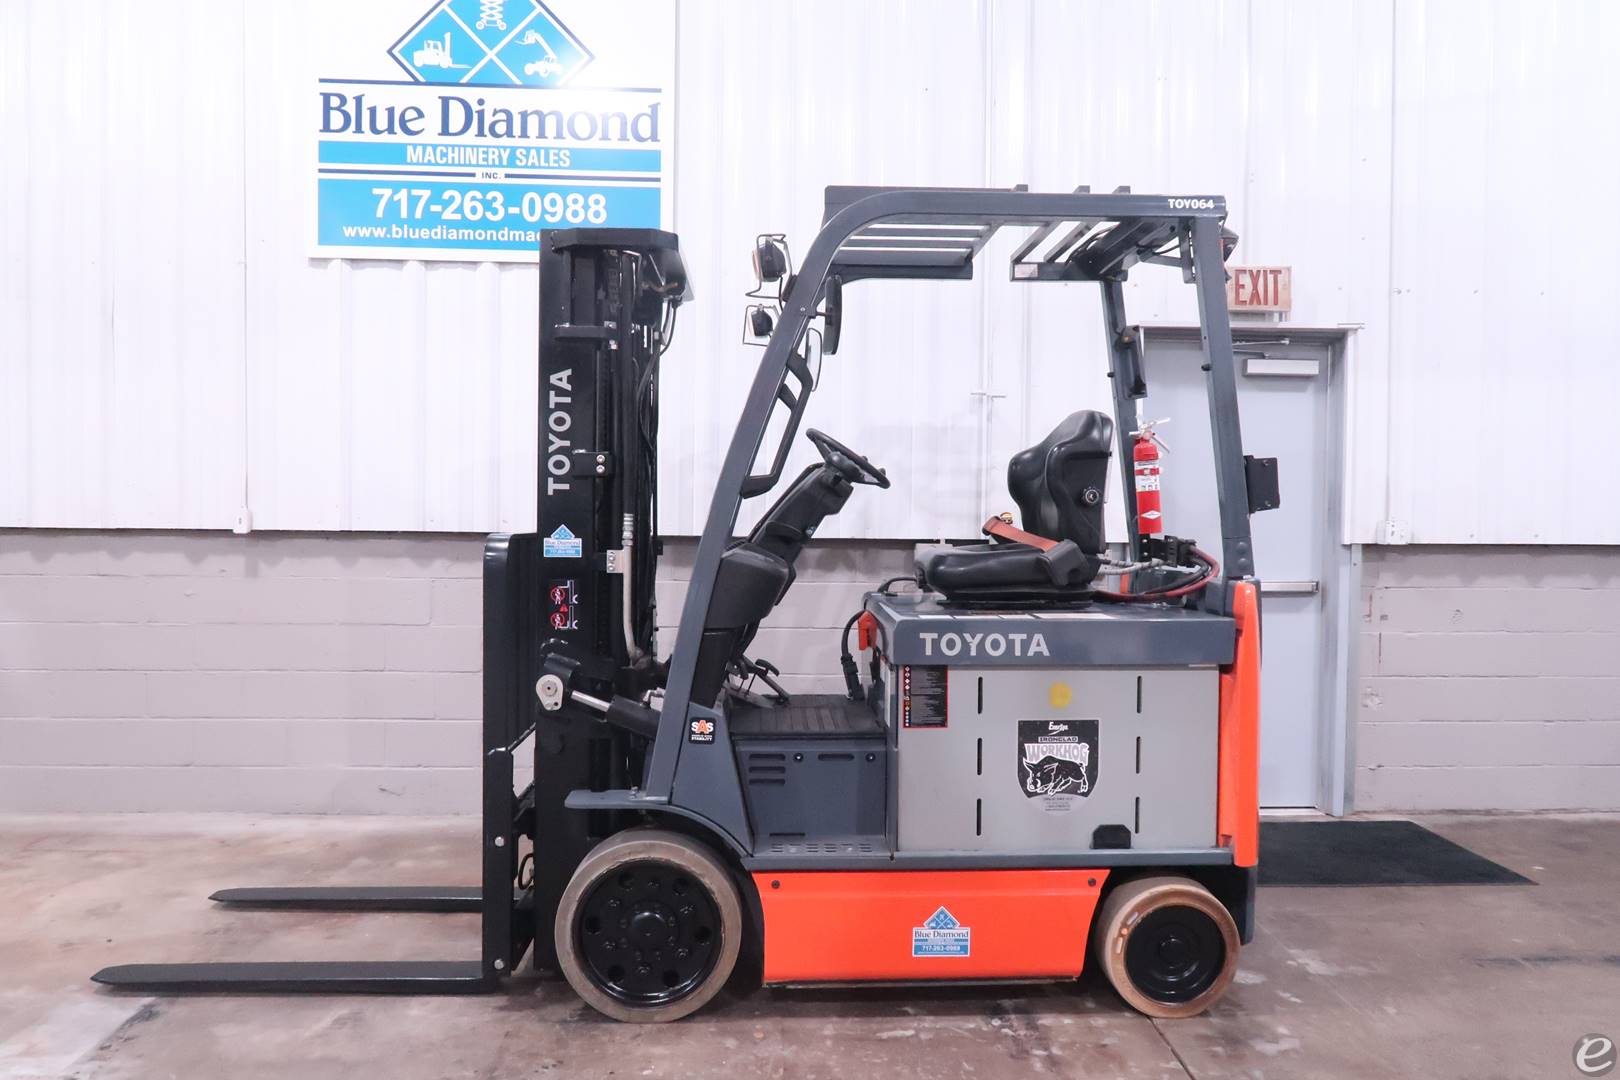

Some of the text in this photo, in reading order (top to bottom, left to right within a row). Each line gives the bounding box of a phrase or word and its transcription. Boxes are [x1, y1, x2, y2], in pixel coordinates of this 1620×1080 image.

[319, 91, 661, 143] Blue Diamond
[406, 144, 571, 168] MACHINERY SALES
[481, 171, 502, 180] INC.
[371, 187, 608, 224] 717-263-0988
[1167, 198, 1215, 209] TOY064
[1234, 269, 1282, 306] EXIT
[547, 368, 573, 496] TOYOTA
[919, 632, 1050, 657] TOYOTA
[691, 719, 714, 734] SAS
[1024, 742, 1089, 766] WORKHOG
[914, 930, 969, 938] Blue Diamond
